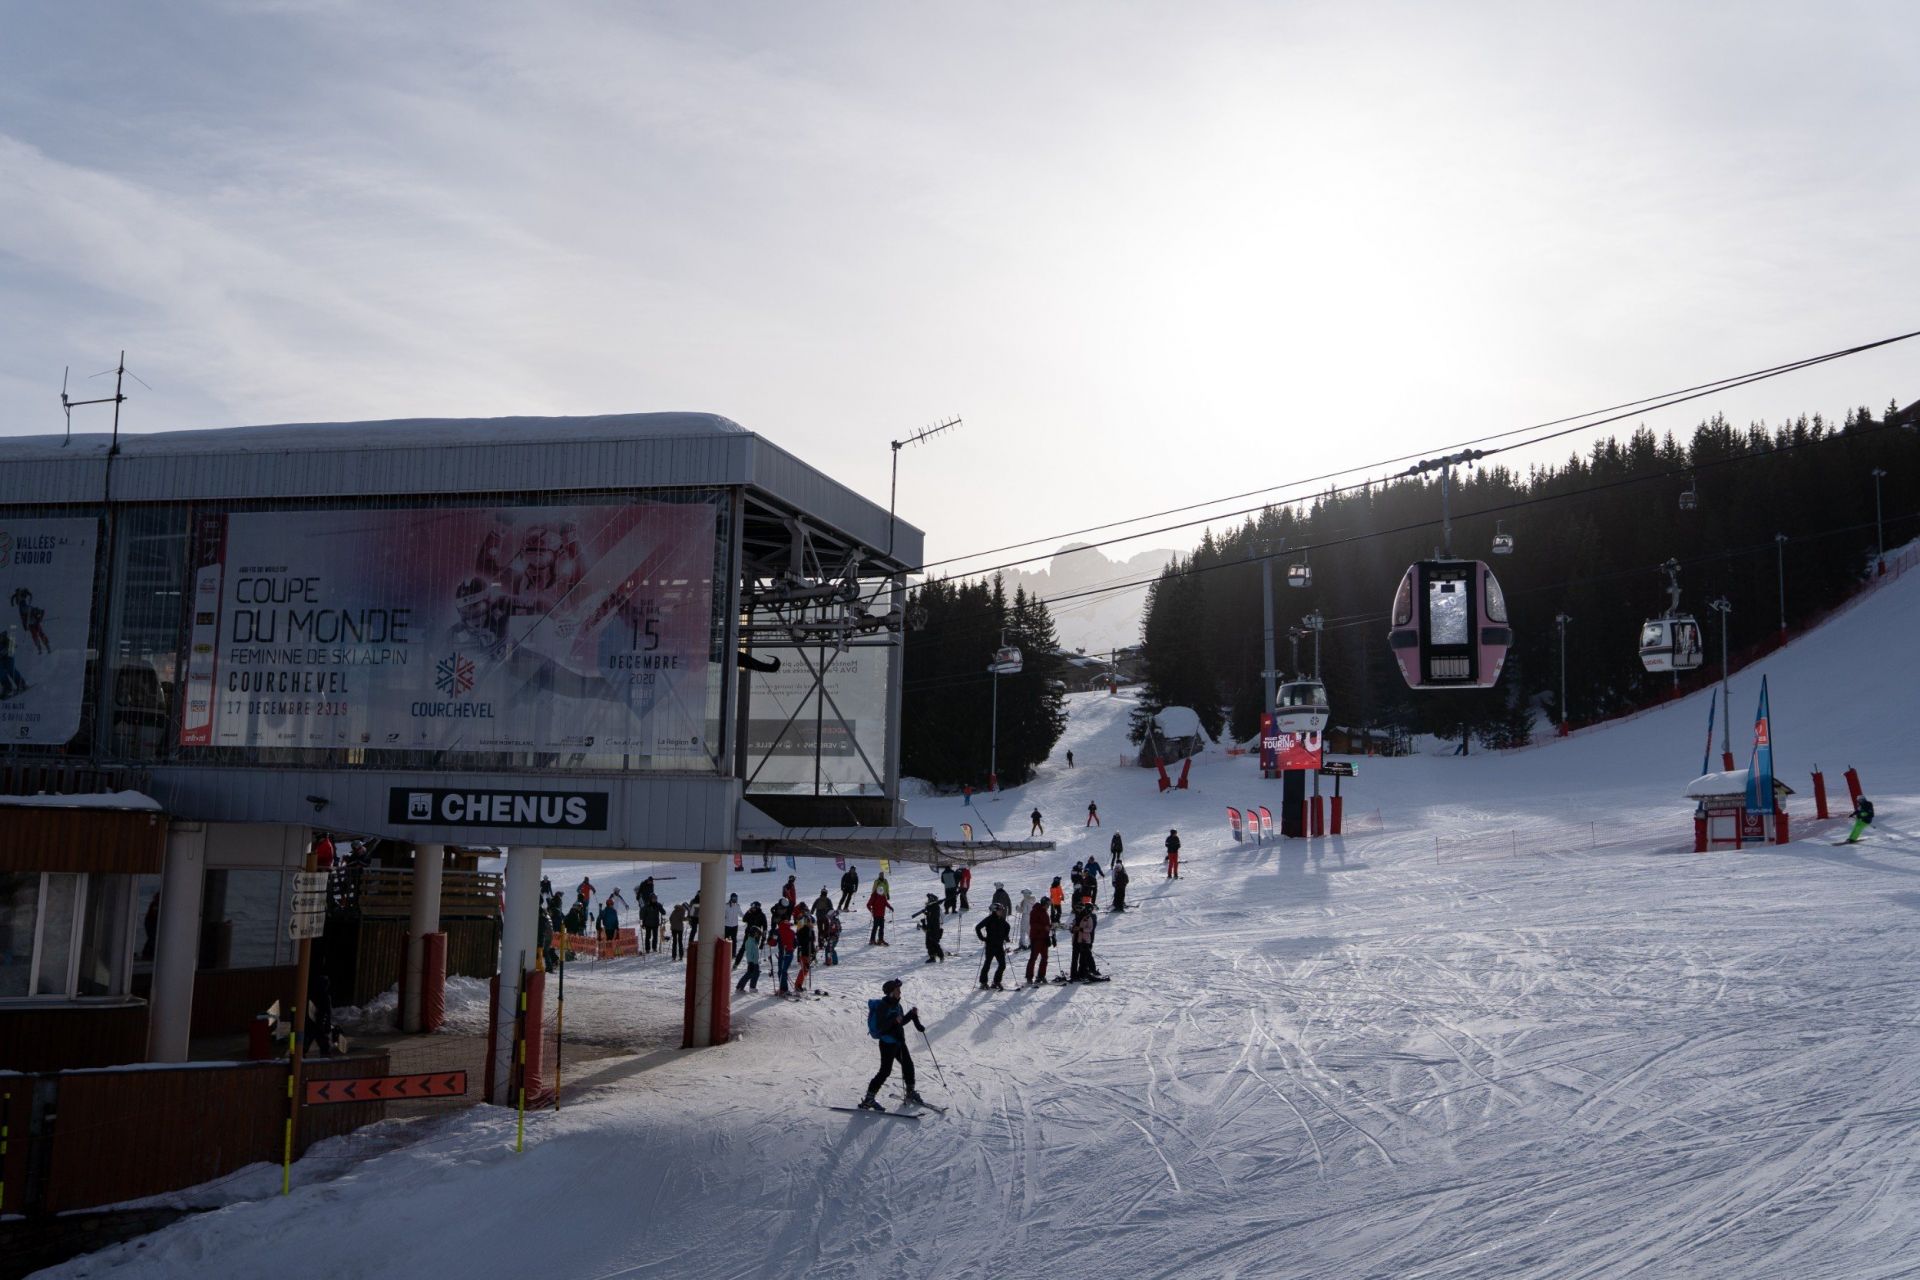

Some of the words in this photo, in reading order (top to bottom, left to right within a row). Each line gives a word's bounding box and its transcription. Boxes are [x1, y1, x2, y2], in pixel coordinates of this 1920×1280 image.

[16, 534, 56, 550] VALLÉES
[14, 551, 52, 565] ENDURO
[236, 577, 320, 603] COUPE
[233, 609, 276, 644] DU
[287, 609, 410, 644] MONDE
[632, 619, 660, 651] 15
[230, 648, 304, 665] FEMININE
[306, 648, 328, 665] DE
[332, 648, 357, 665] SKI
[361, 648, 408, 665] ALPIN
[609, 655, 679, 669] DECEMBRE
[228, 671, 349, 693] COURCHEVEL
[629, 673, 656, 685] 2020
[227, 701, 242, 715] 17
[248, 701, 310, 715] DECEMBRE
[317, 701, 348, 715] 2019
[411, 702, 494, 718] COURCHEVEL
[1262, 740, 1295, 749] TOURING
[1278, 734, 1290, 742] SKI
[441, 793, 587, 825] CHENUS
